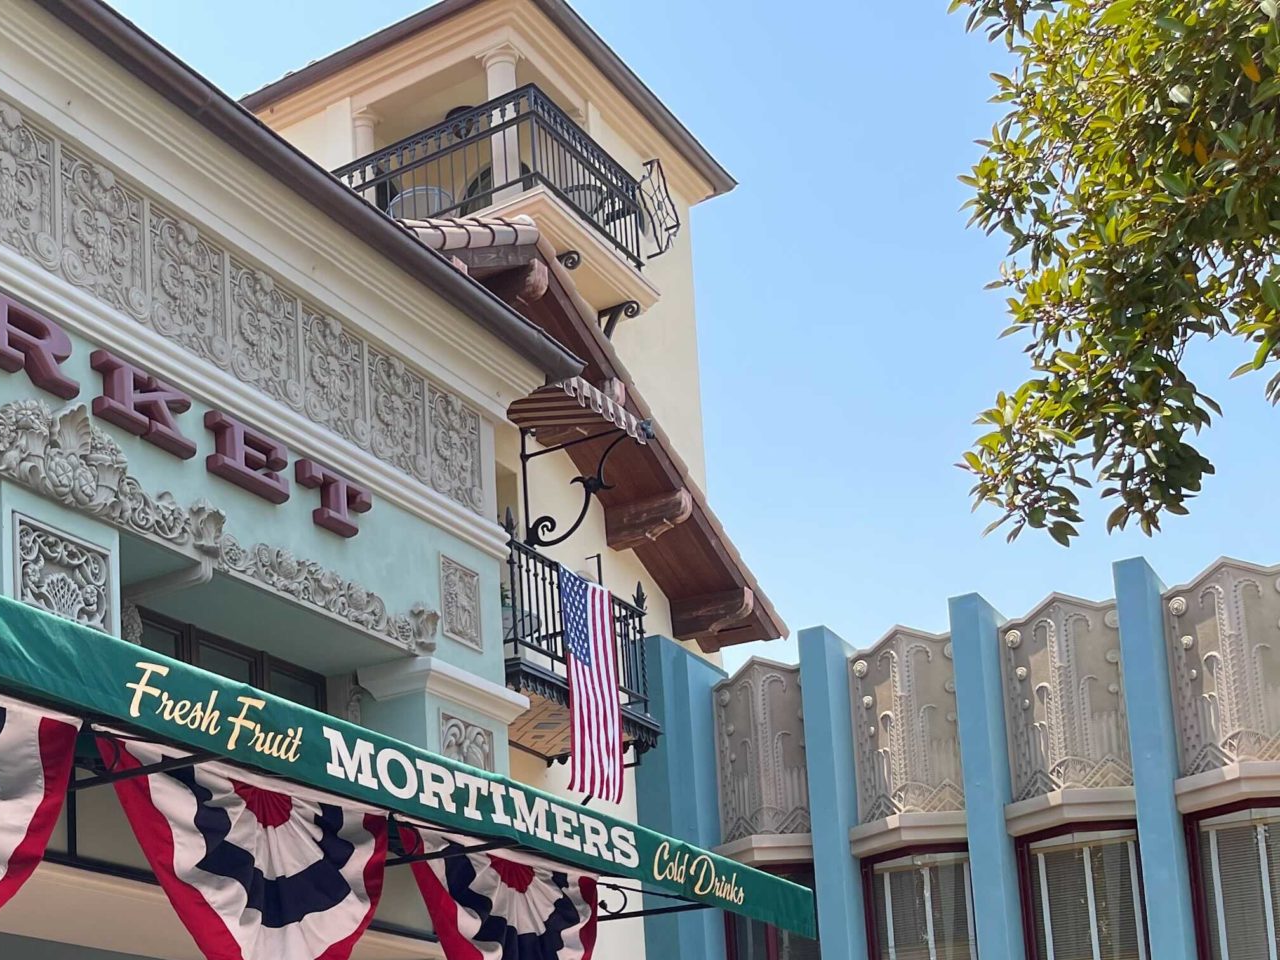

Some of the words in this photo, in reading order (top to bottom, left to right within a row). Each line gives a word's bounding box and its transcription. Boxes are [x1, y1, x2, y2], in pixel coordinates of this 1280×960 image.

[126, 661, 220, 736] Fresh
[227, 696, 303, 763] Fruit
[323, 726, 639, 869] MORTIMERS
[653, 841, 688, 885] Cold
[689, 854, 745, 905] Drinks
